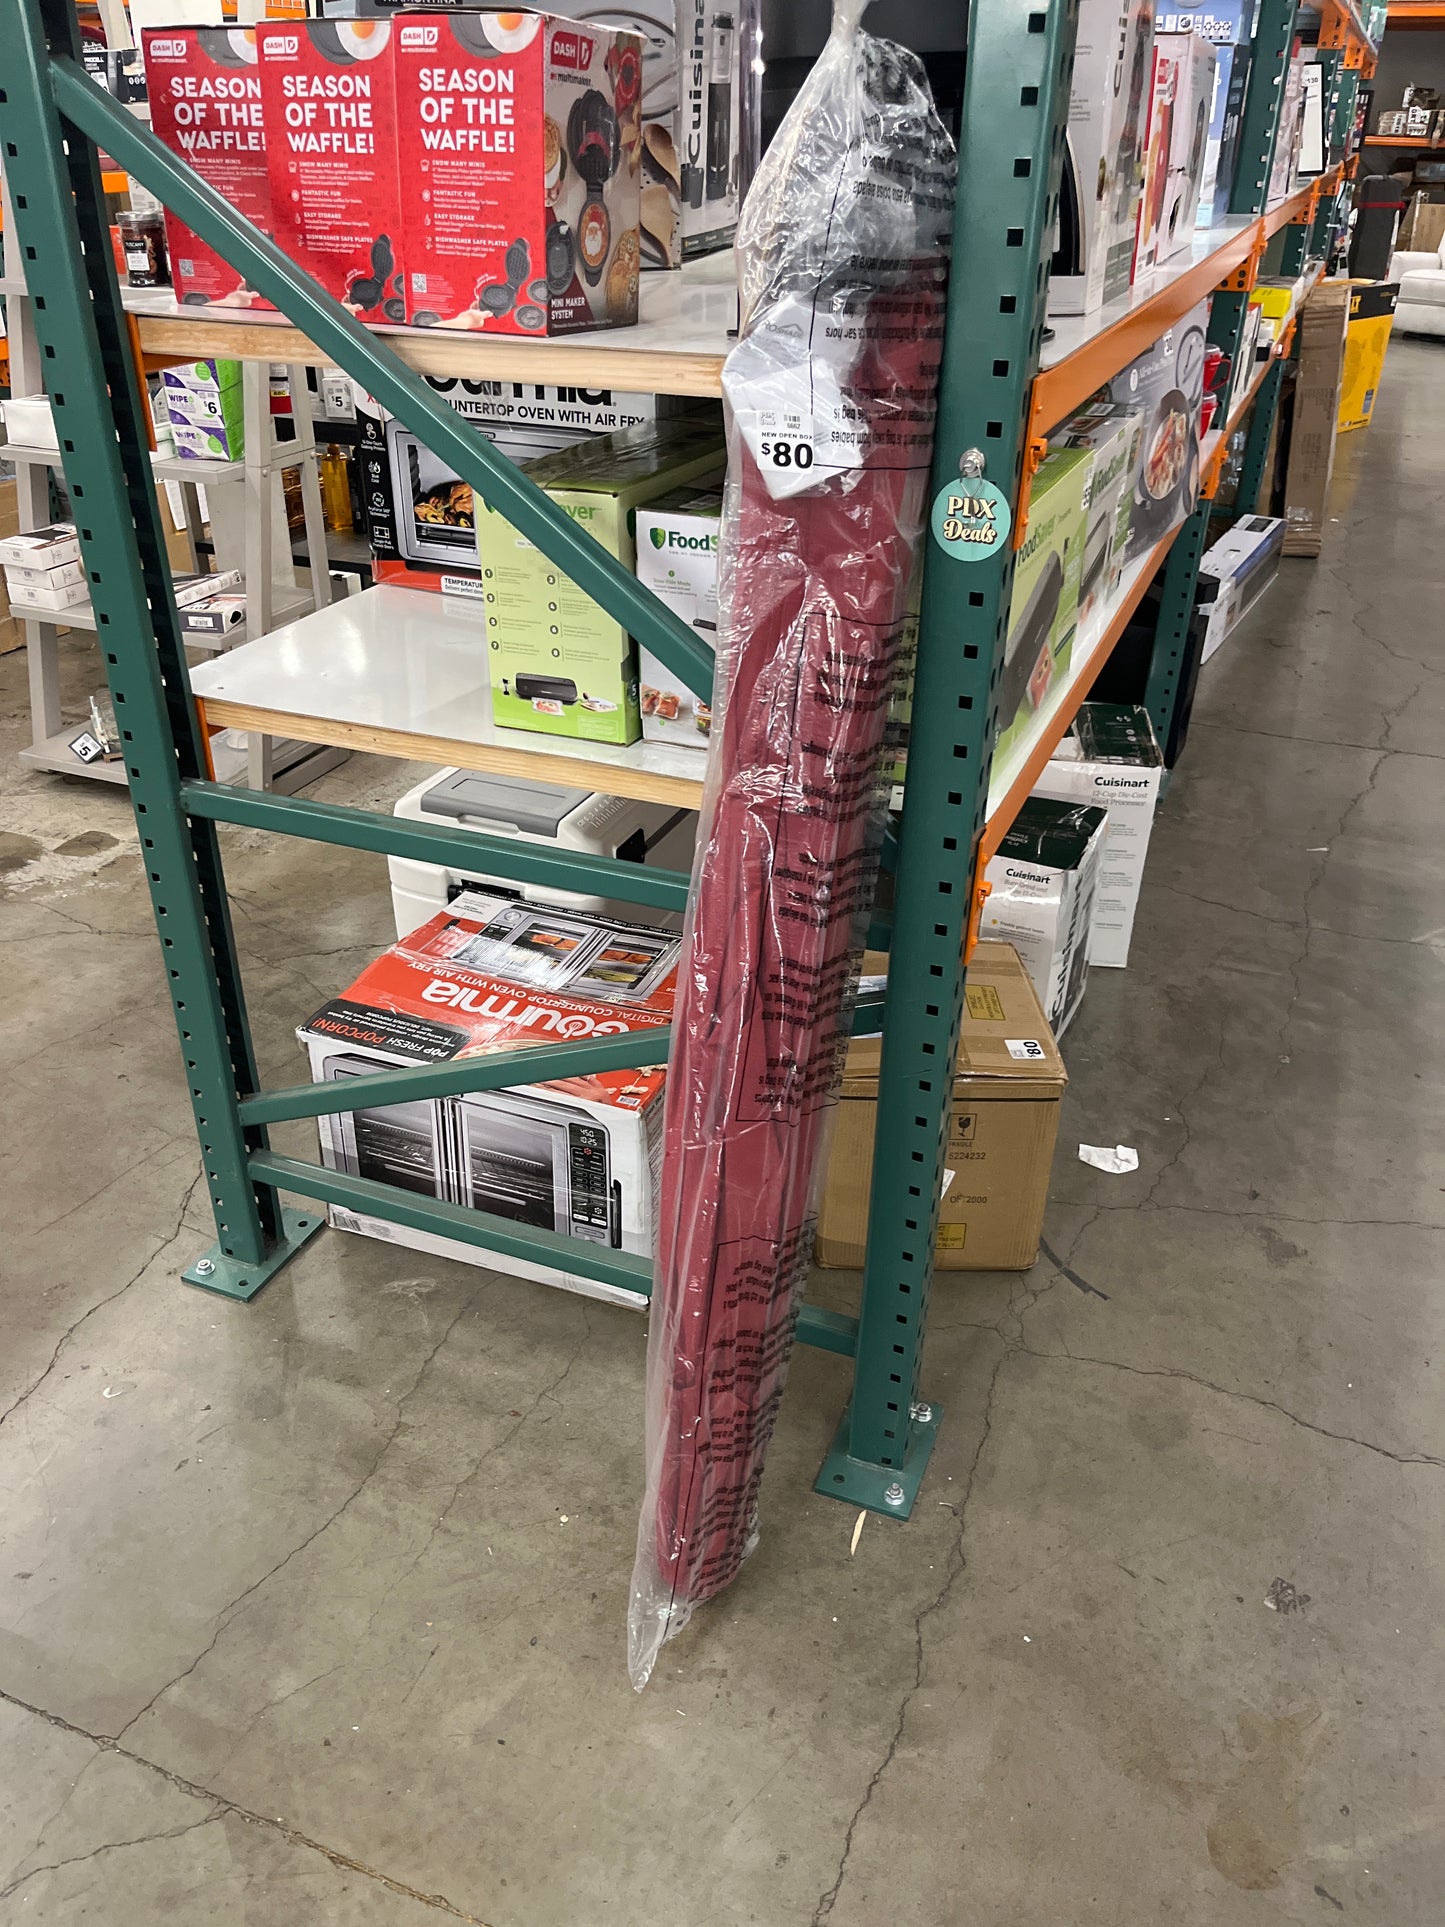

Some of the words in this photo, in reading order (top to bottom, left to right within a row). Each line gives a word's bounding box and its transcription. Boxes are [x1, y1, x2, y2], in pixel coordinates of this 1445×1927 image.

[403, 32, 421, 40] DASH
[152, 43, 171, 51] DASH
[265, 42, 283, 50] DASH
[553, 41, 576, 58] DASH
[170, 76, 262, 99] SEASON
[282, 74, 371, 98] SEASON
[418, 68, 514, 93] SEASON
[174, 102, 207, 126] OF
[214, 102, 264, 127] THE
[285, 102, 317, 127] OF
[323, 102, 373, 128] THE
[420, 97, 454, 123] OF
[461, 97, 515, 125] THE
[176, 130, 267, 151] WAFFLE!
[286, 132, 375, 154] WAFFLE!
[420, 128, 515, 153] WAFFLE!
[434, 212, 448, 220] EASY
[449, 213, 475, 221] STORAGE
[435, 236, 472, 244] DISHWASHER
[472, 237, 486, 245] SAFE
[488, 238, 508, 247] PLATES
[551, 298, 564, 308] MINI
[565, 297, 585, 307] MAKER
[551, 309, 573, 320] SYSTEM
[203, 401, 218, 414] $6
[331, 395, 344, 407] $5
[443, 399, 514, 417] UNTERTOP
[517, 405, 555, 421] OVEN
[557, 409, 591, 424] WITH
[594, 412, 617, 427] AIR
[831, 430, 856, 447] babies
[761, 441, 813, 469] $80
[946, 495, 997, 520] PDX
[942, 517, 998, 545] Deals
[79, 742, 92, 756] $5
[1094, 776, 1150, 789] Cuisinart
[1090, 797, 1110, 806] Food
[1110, 799, 1146, 807] Processor
[1117, 791, 1148, 800] Die-Cast
[1005, 868, 1051, 885] Cuisinart
[408, 961, 432, 973] FRY
[433, 968, 456, 979] AIR
[455, 972, 489, 990] WITH
[489, 981, 527, 998] OVEN
[421, 980, 630, 1040] Gourmia
[528, 995, 613, 1018] COUNTERTOP
[392, 1018, 421, 1029] DELICIOUS
[615, 1010, 666, 1025] DIGITAL
[311, 1018, 387, 1045] POPCORN!
[386, 1036, 425, 1054] FRESH
[423, 1046, 449, 1058] POP
[1022, 1040, 1042, 1058] $80
[580, 1128, 595, 1138] 450
[948, 1152, 986, 1160] 5224232
[966, 1195, 987, 1204] 2000
